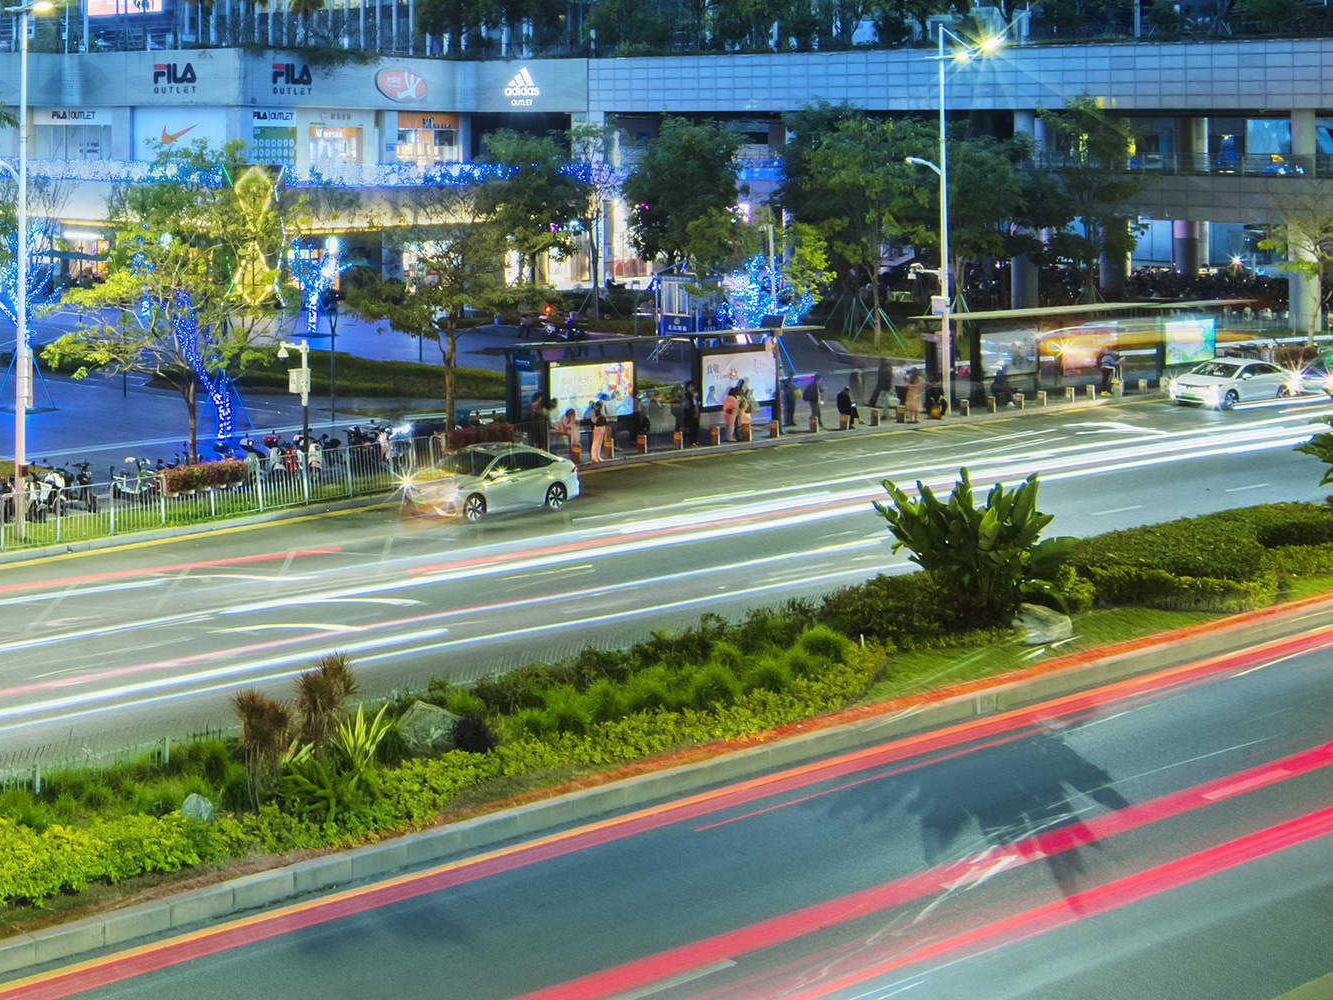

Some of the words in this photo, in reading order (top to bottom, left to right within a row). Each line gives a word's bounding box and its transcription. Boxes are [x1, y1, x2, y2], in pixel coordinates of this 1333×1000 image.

[153, 62, 197, 84] FILA
[272, 63, 313, 85] FILA
[153, 86, 197, 94] OUTLET
[273, 87, 313, 95] OUTLET
[504, 84, 540, 97] adidas
[510, 98, 533, 106] OUTLET
[51, 110, 67, 120] FILA
[70, 110, 96, 120] OUTLET
[253, 111, 268, 120] FILA
[270, 111, 294, 120] OUTLET
